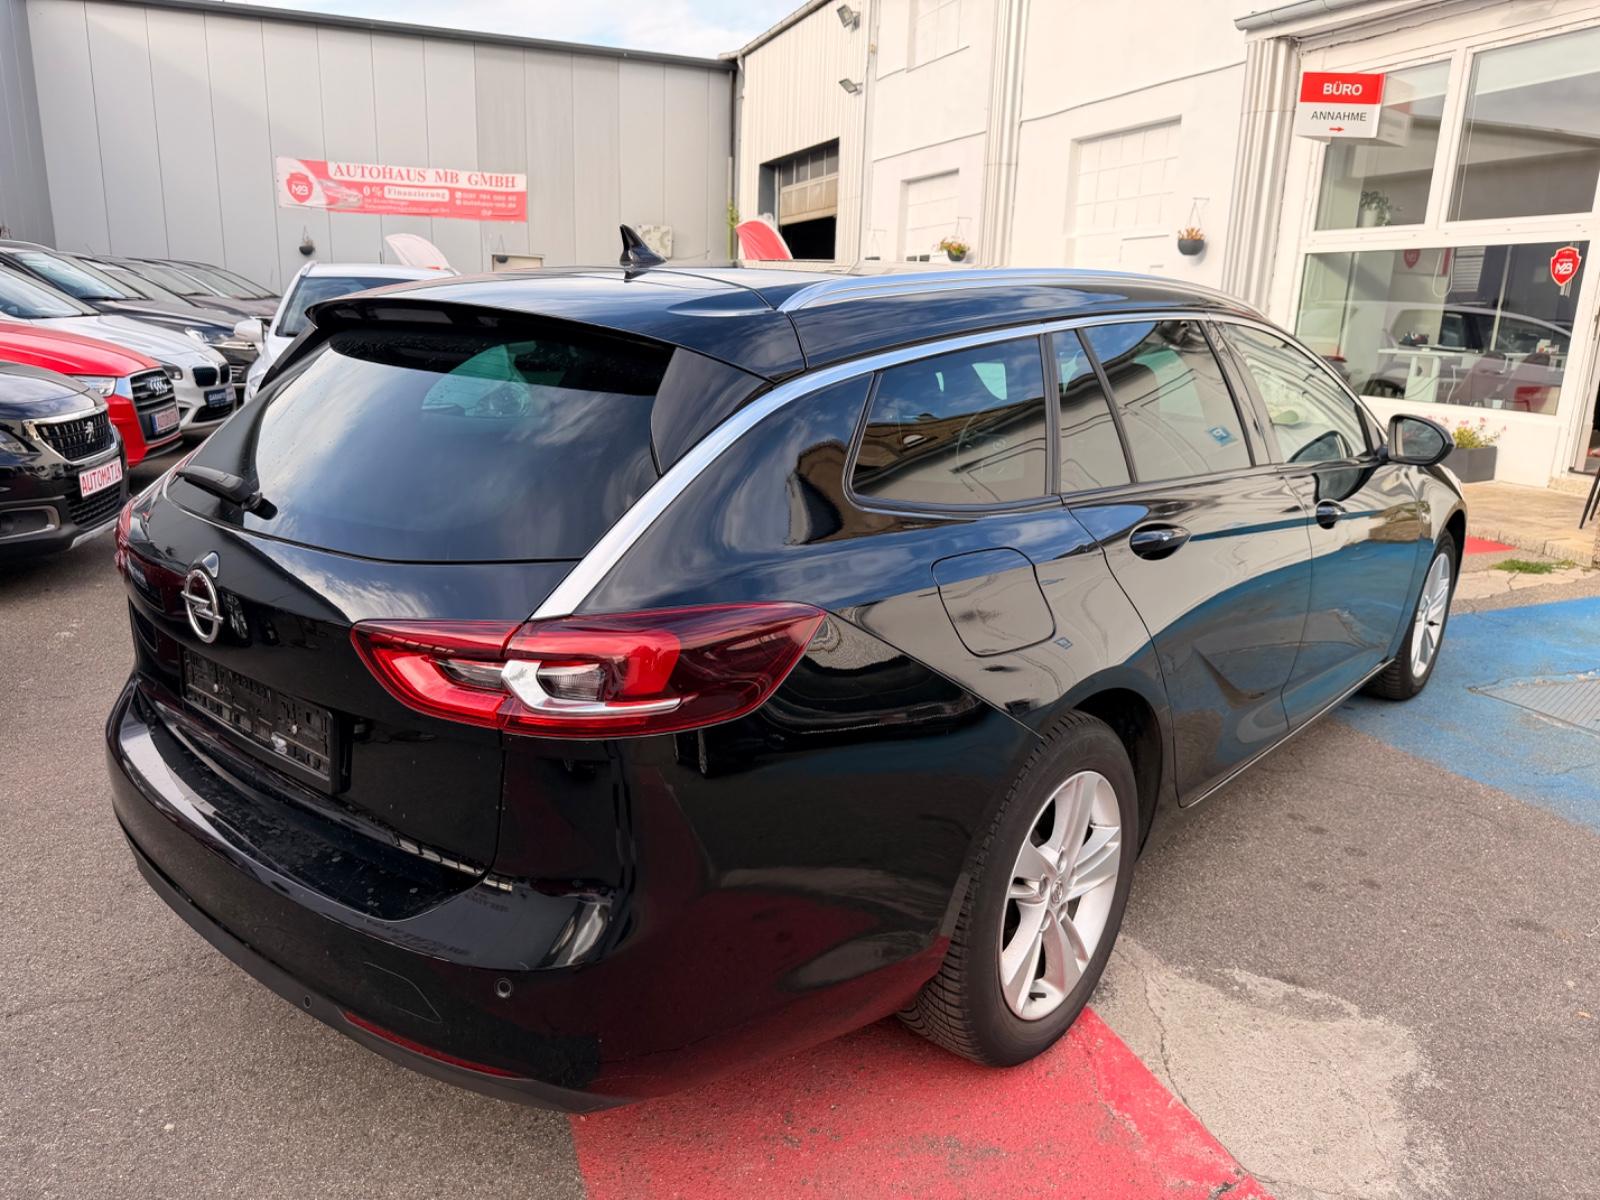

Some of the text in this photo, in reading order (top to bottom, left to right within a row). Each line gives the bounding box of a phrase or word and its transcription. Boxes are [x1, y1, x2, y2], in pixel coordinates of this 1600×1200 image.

[1322, 81, 1363, 96] BÜRO
[1310, 111, 1367, 122] ANNAHME
[333, 163, 517, 188] AUTOHAUS MB GMBH
[386, 187, 447, 200] Finanzierung
